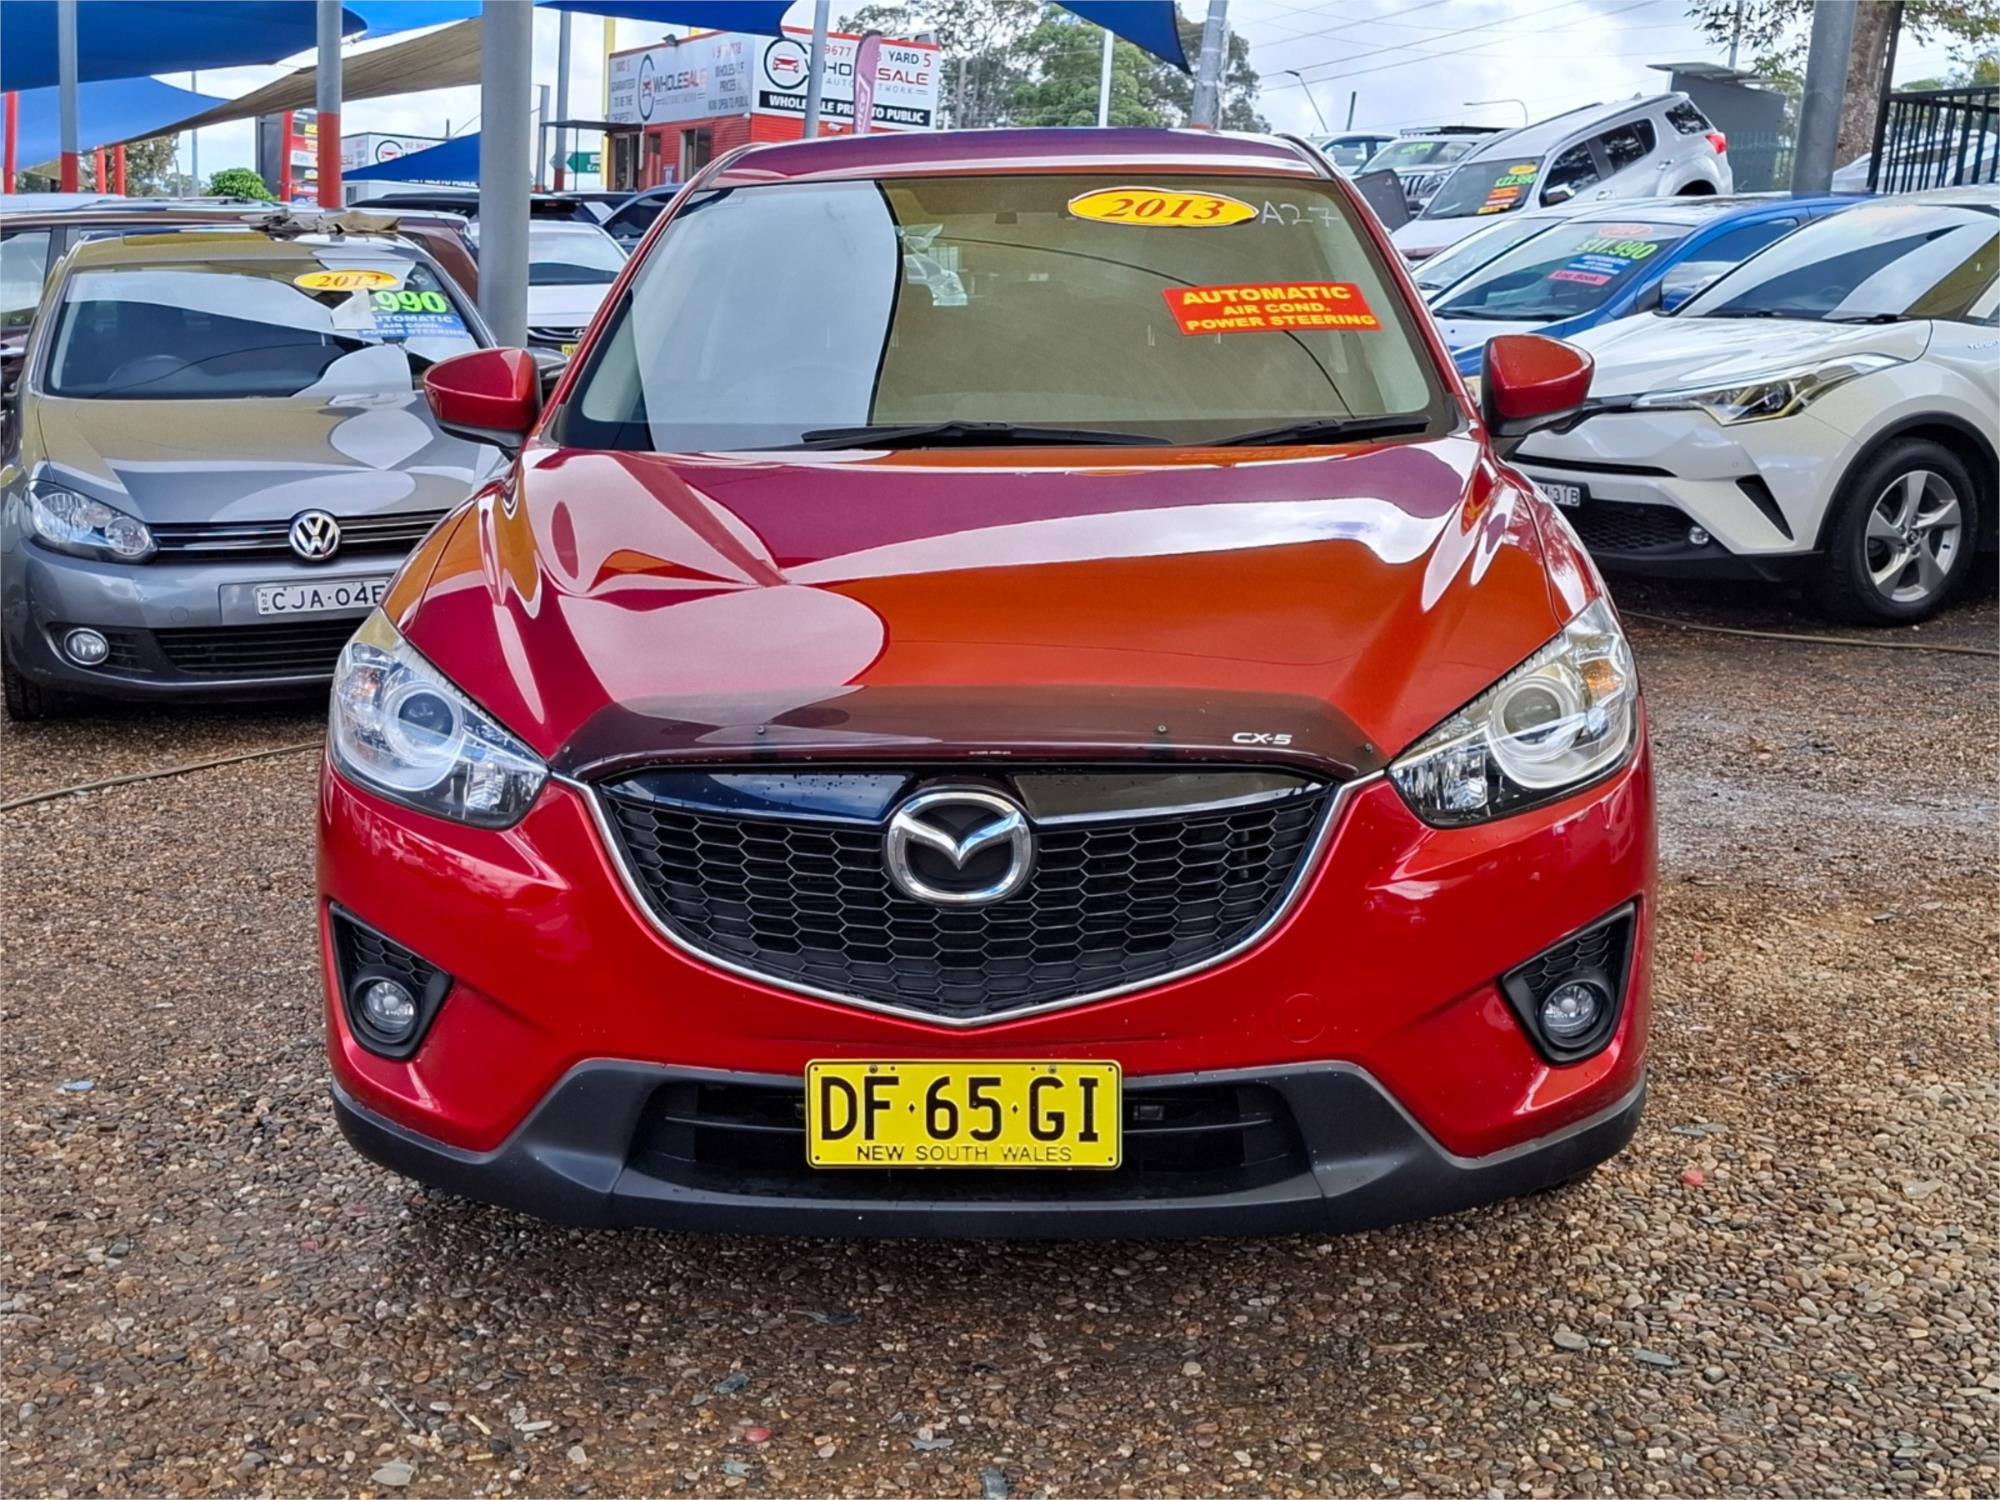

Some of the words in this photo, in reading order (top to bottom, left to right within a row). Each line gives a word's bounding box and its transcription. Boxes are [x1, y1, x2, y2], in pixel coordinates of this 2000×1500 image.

[888, 51, 920, 65] YARD
[922, 53, 932, 68] 5
[653, 68, 708, 93] WHOLESALE
[804, 57, 929, 86] HOSALE
[879, 84, 913, 95] TWORK
[768, 94, 835, 114] WHOLELE
[886, 108, 925, 123] PUBLIC
[1101, 197, 1226, 220] 2013
[1261, 200, 1341, 228] A27
[1182, 285, 1352, 306] AUTOMATIC
[1223, 304, 1260, 316] AIR
[1264, 302, 1332, 314] COND.
[1185, 316, 1271, 332] POWER
[1273, 313, 1377, 327] STEERING
[1232, 732, 1293, 745] CX-5
[857, 1145, 905, 1162] NEW
[915, 1146, 988, 1162] SOUTH
[1001, 1146, 1073, 1162] WALES
